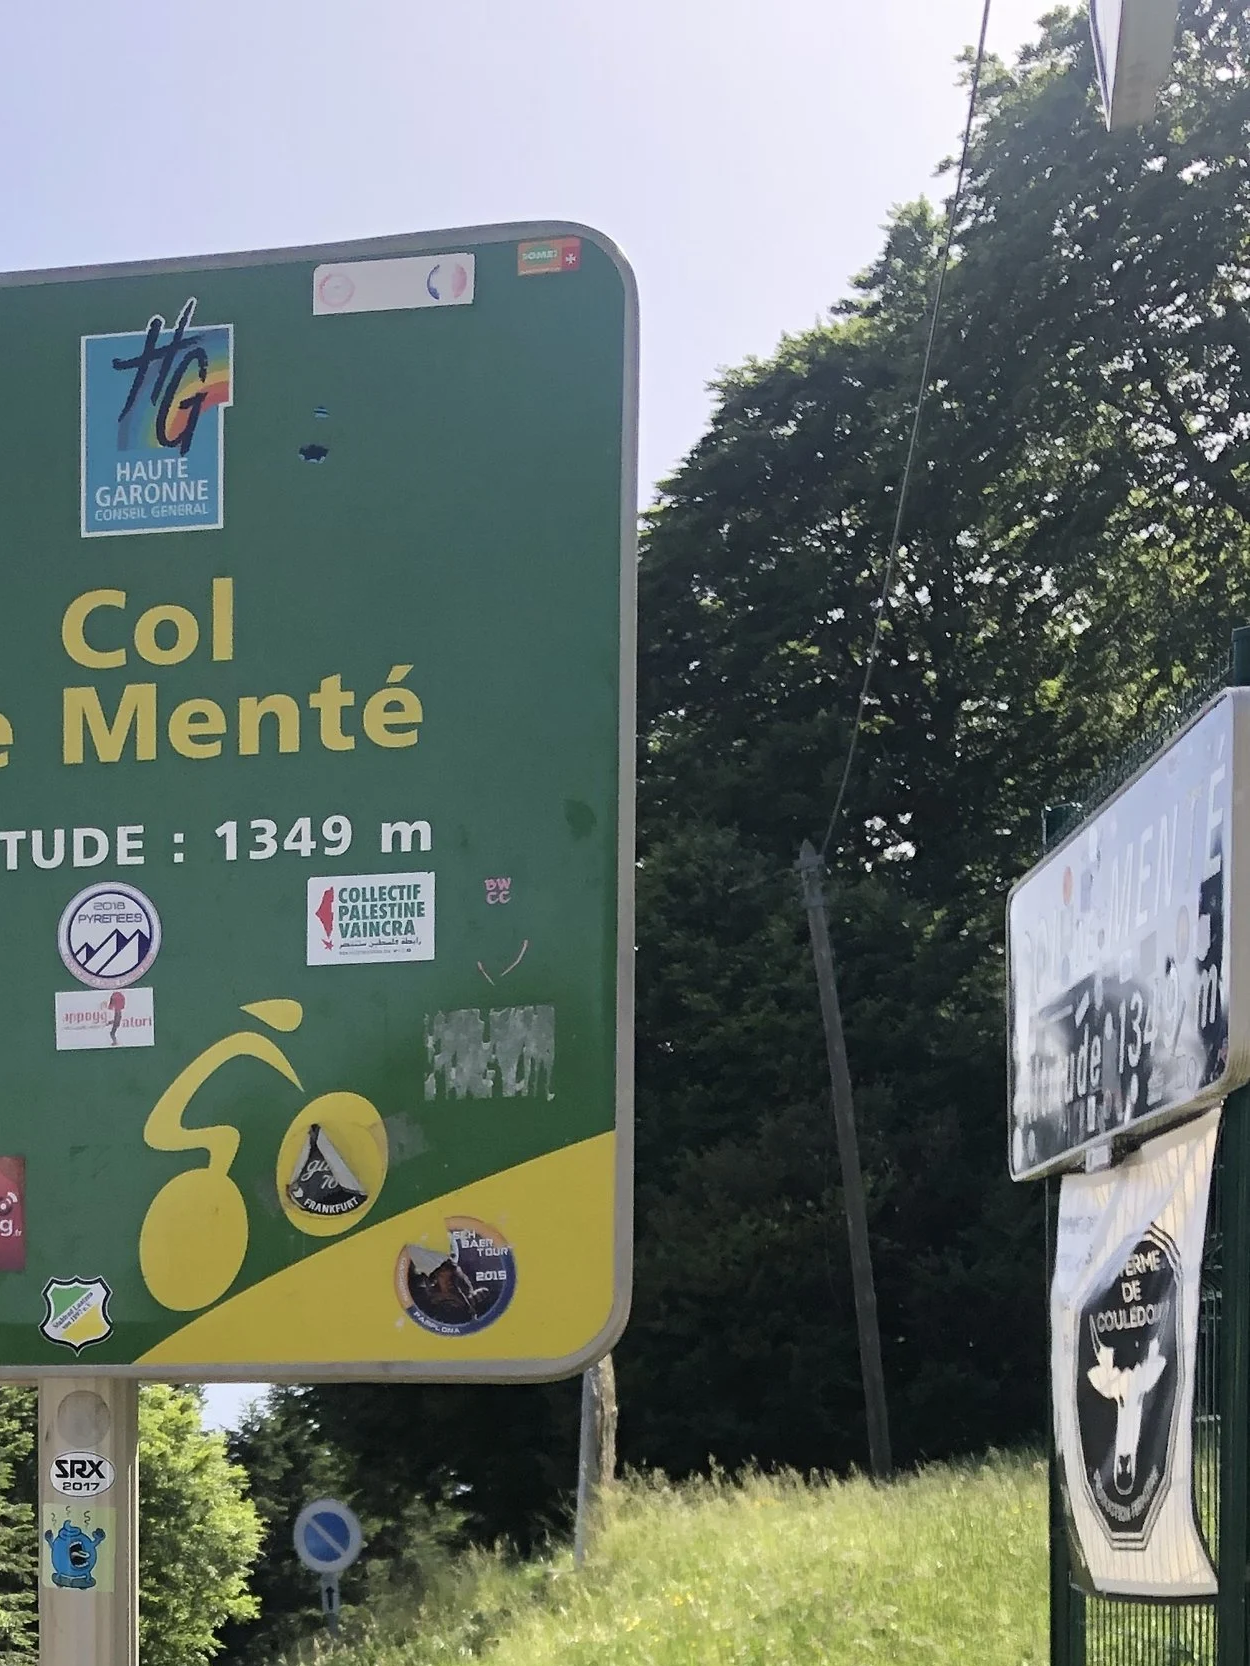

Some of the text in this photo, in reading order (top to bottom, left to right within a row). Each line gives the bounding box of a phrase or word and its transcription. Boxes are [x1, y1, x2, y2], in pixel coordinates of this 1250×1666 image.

[112, 298, 209, 457] HG
[116, 457, 189, 483] HAUTE
[95, 479, 209, 507] GARONNE
[94, 507, 147, 522] CONSEIL
[61, 577, 233, 670] Col
[62, 665, 424, 764] Menté
[173, 831, 185, 864] :
[214, 814, 353, 862] 1349
[381, 818, 433, 853] m
[338, 884, 421, 904] COLLECTIF
[93, 901, 126, 911] 2018
[338, 901, 426, 922] PALESTINE
[78, 912, 143, 925] PYRENEES
[338, 919, 416, 939] VAINCRA
[1117, 966, 1181, 1074] 1349
[304, 1196, 359, 1214] FRANKFURT
[461, 1238, 494, 1249] BAER
[476, 1247, 510, 1257] TOUR
[1120, 1249, 1161, 1278] ERME
[476, 1270, 507, 1282] 2015
[1121, 1280, 1143, 1304] DE
[55, 1459, 106, 1479] SRX
[62, 1482, 100, 1491] 2017
